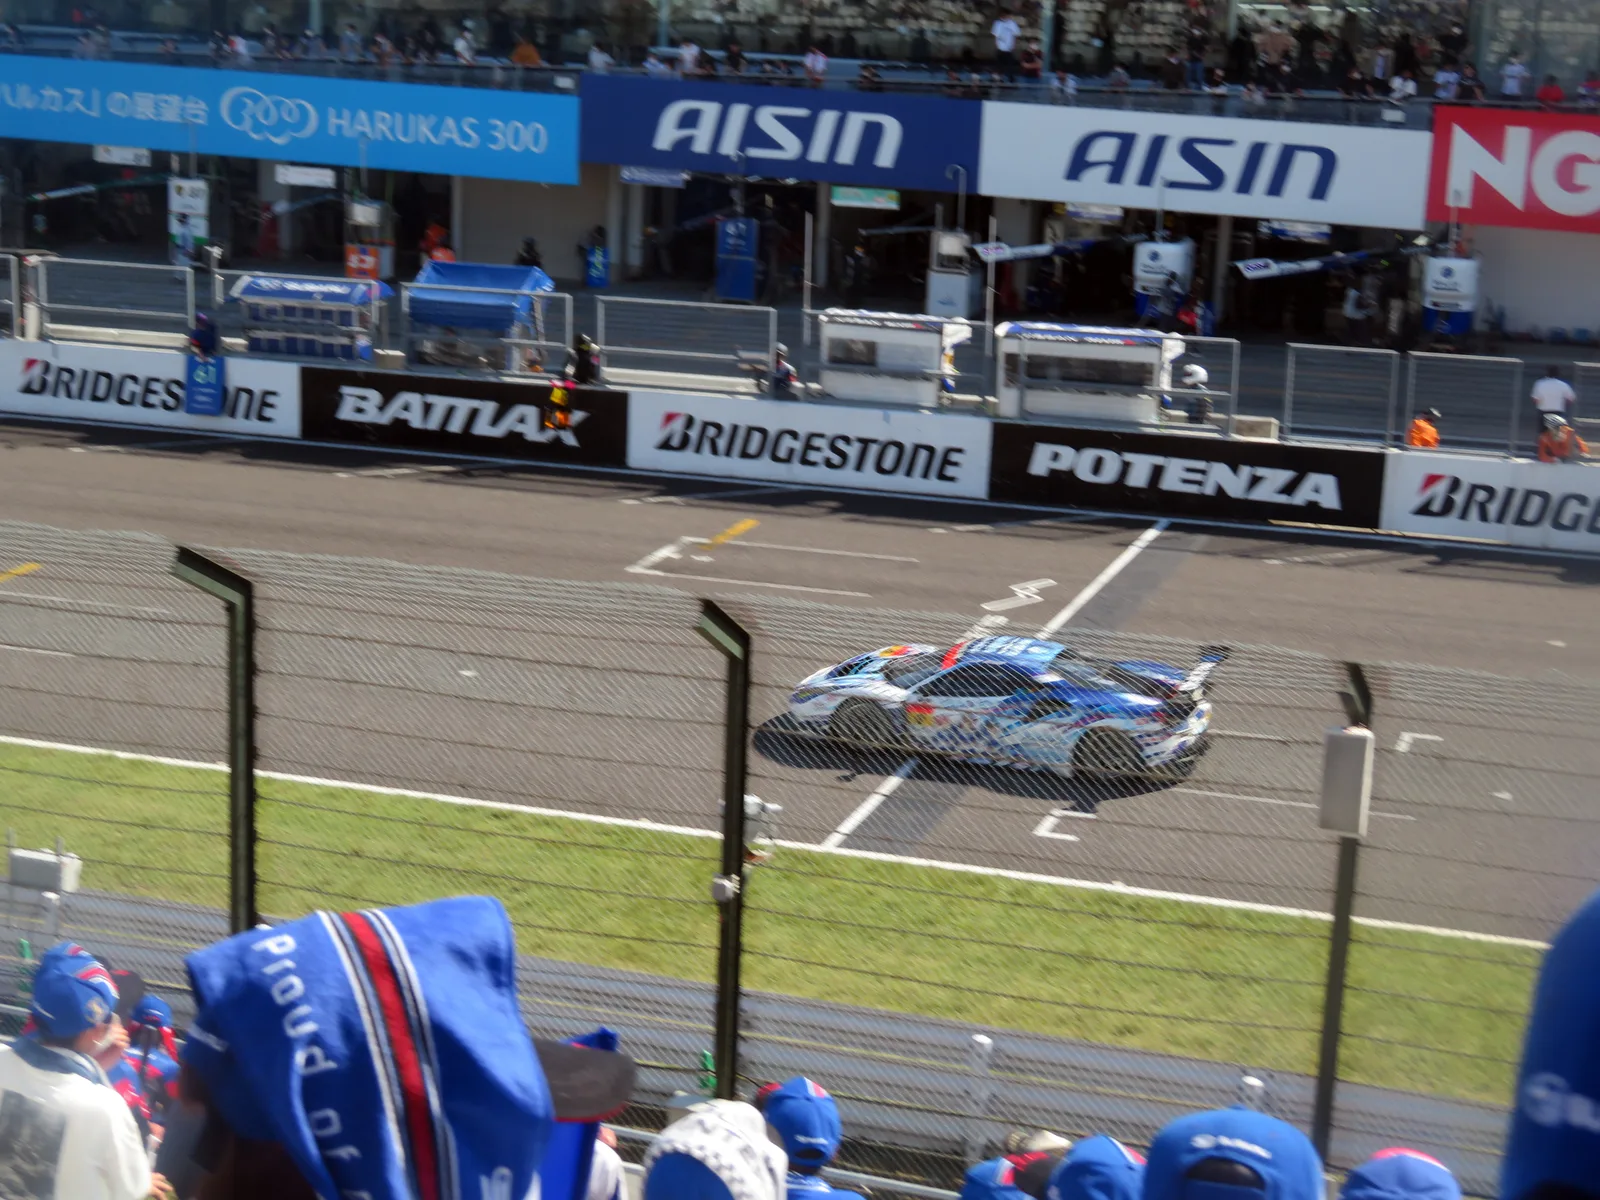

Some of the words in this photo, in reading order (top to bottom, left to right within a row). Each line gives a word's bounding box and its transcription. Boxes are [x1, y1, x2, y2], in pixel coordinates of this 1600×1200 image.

[327, 106, 480, 149] HARUKAS
[487, 118, 548, 154] 300
[652, 99, 903, 168] AISIN
[1062, 130, 1338, 201] AISIN
[18, 358, 279, 422] BRIDGESNE
[654, 411, 966, 483] BRIDGESTONE
[1026, 442, 1342, 510] POTENZA
